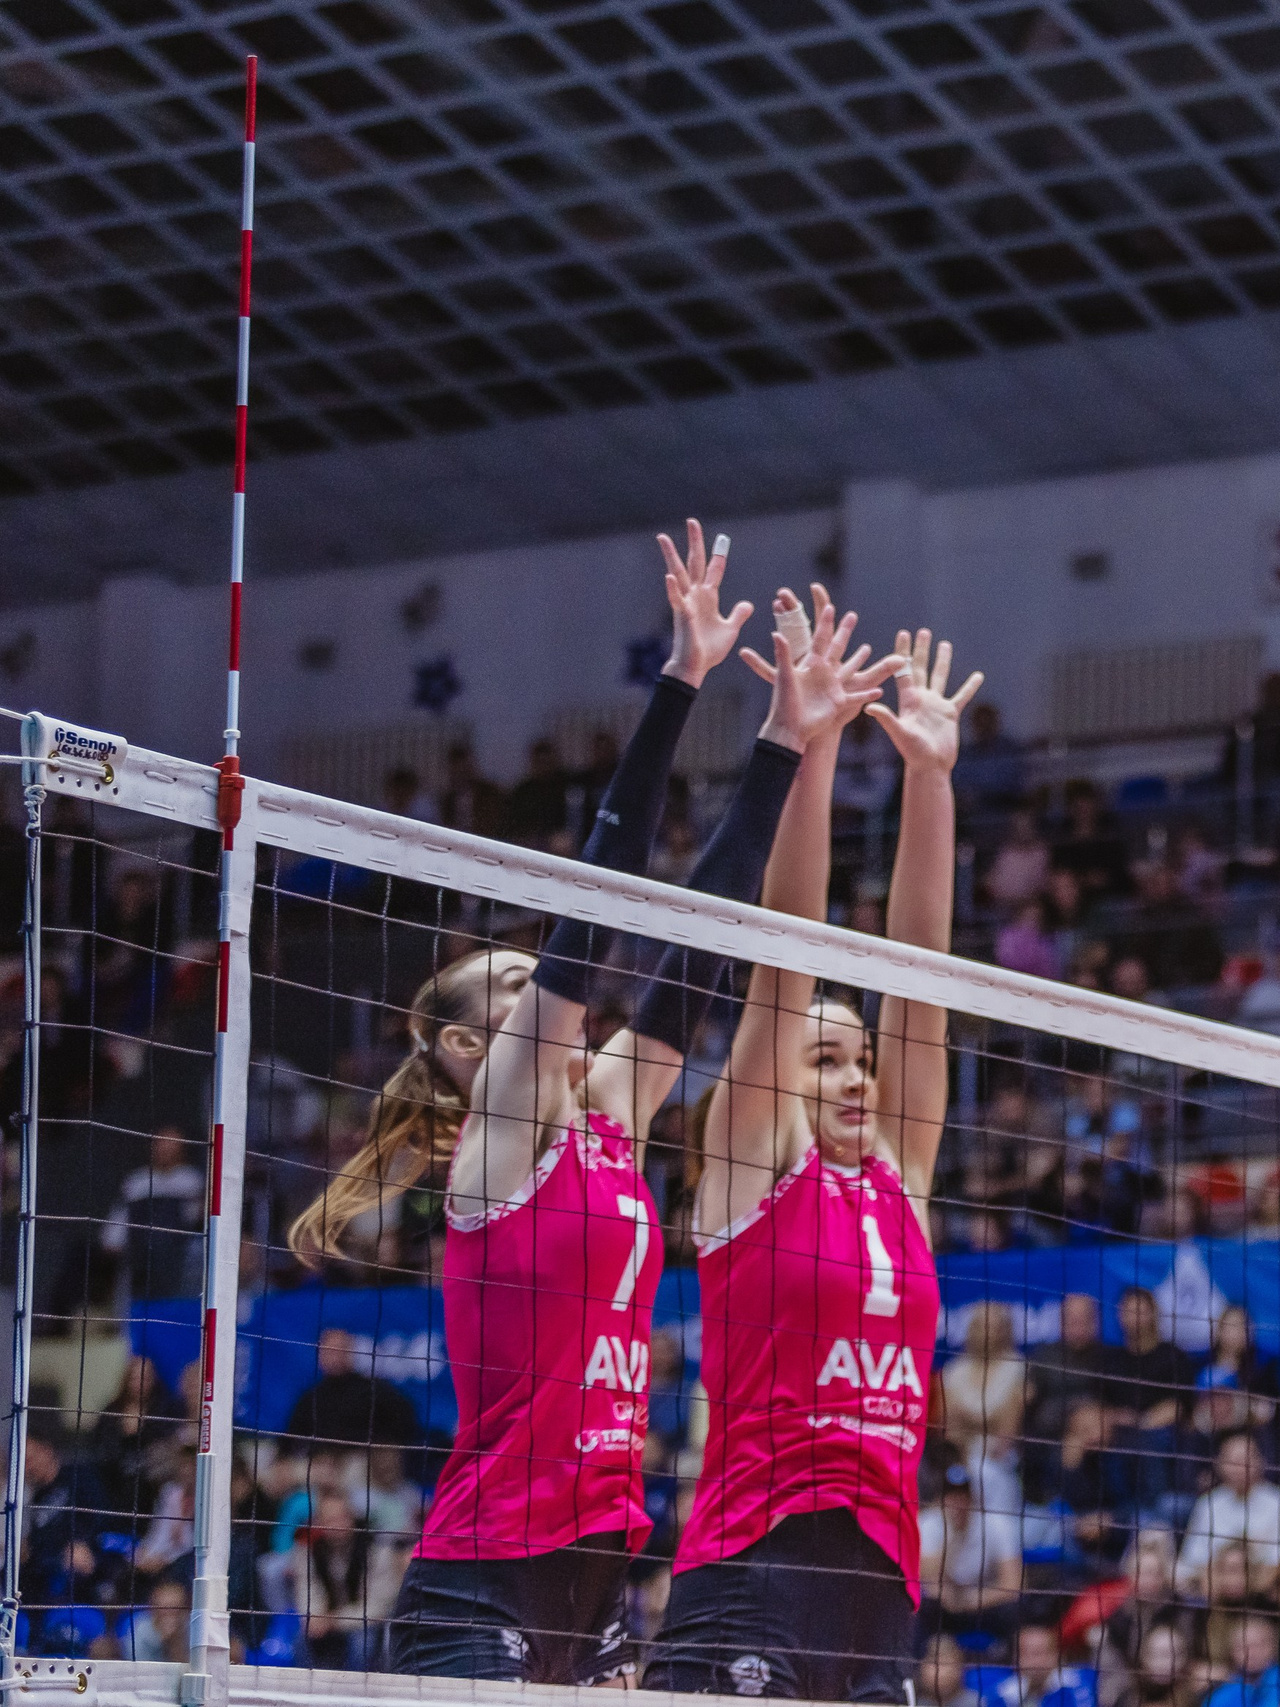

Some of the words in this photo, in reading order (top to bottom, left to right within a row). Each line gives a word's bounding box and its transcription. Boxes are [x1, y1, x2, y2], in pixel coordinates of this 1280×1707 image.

[65, 731, 117, 755] Senoh
[611, 1194, 650, 1312] 7
[861, 1215, 901, 1319] 1
[816, 1338, 923, 1397] AVA
